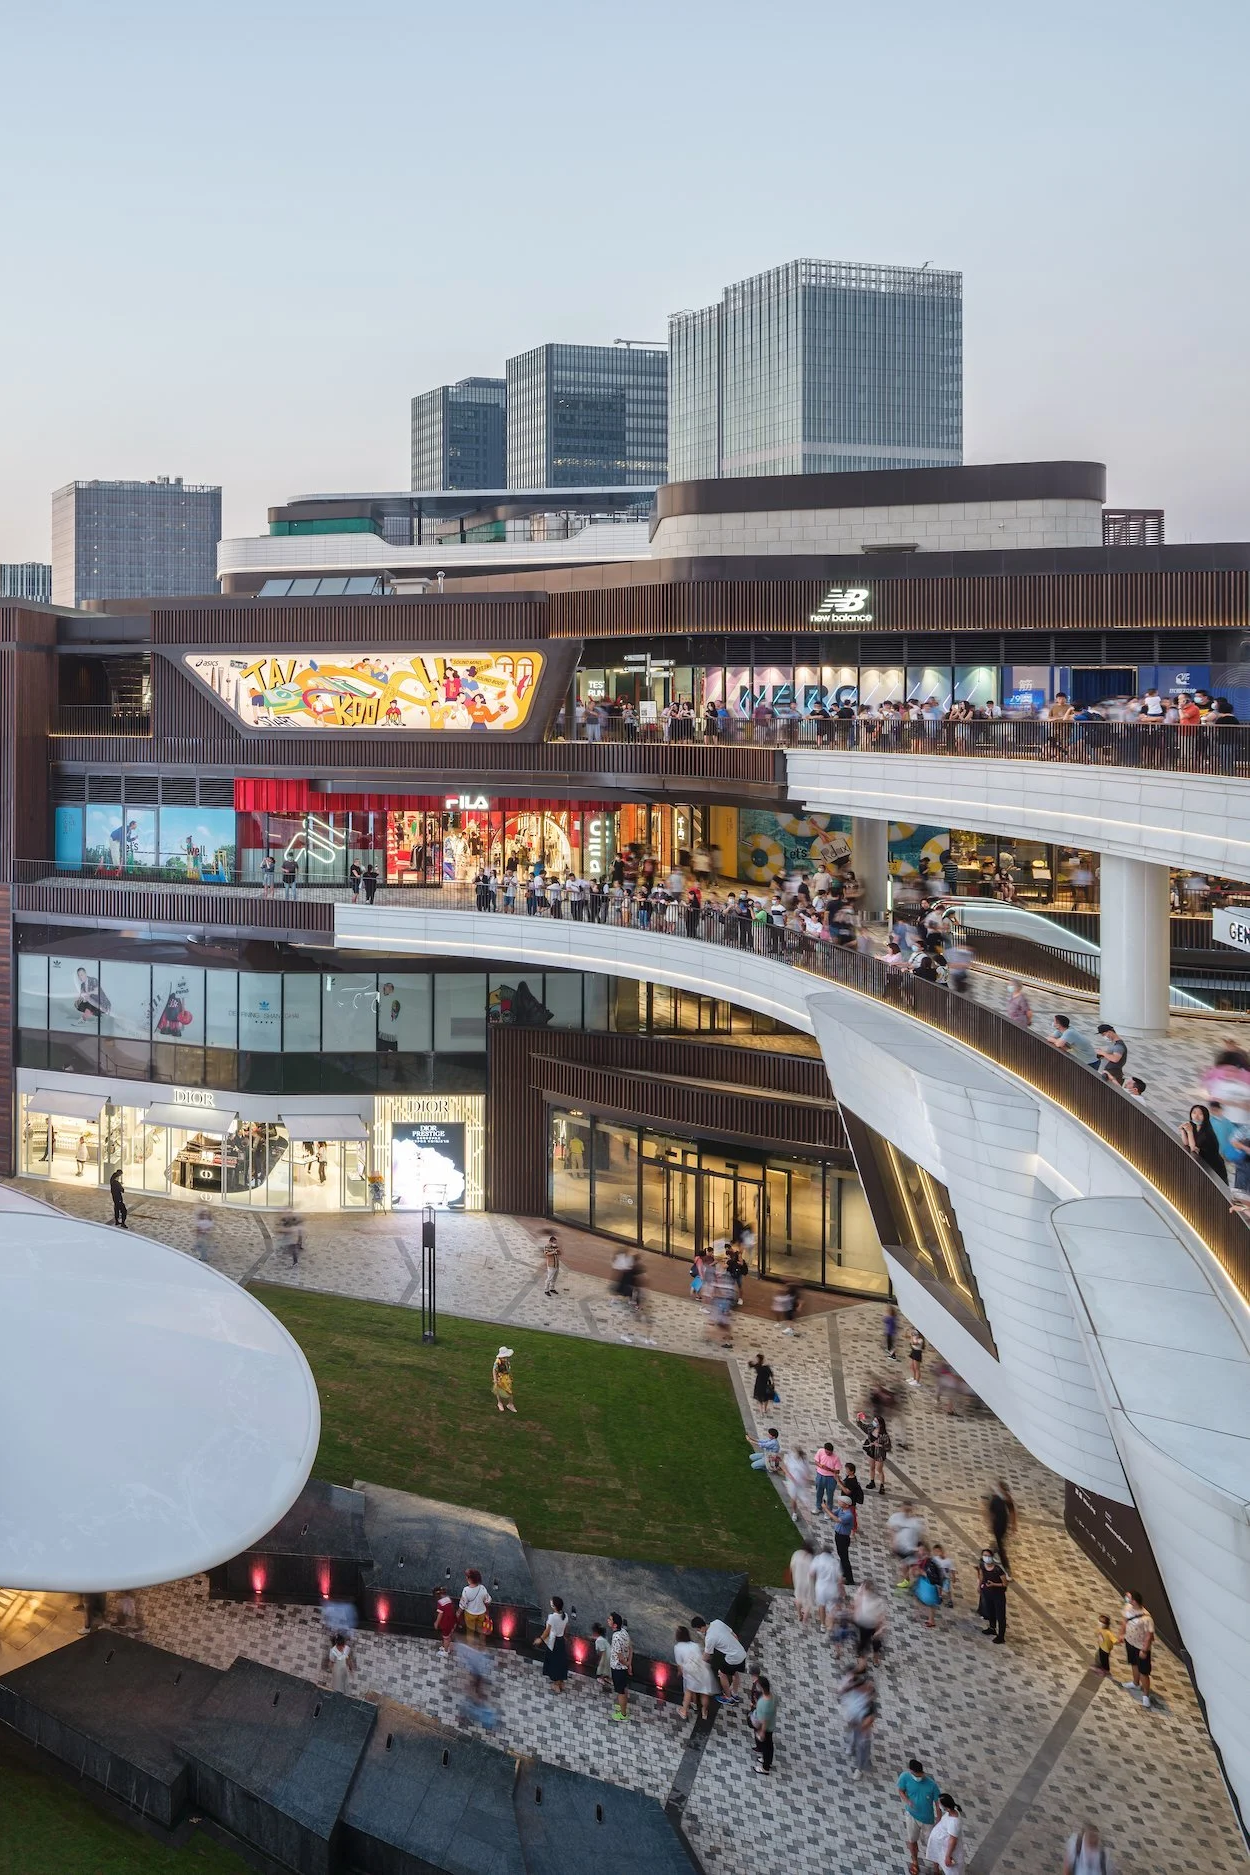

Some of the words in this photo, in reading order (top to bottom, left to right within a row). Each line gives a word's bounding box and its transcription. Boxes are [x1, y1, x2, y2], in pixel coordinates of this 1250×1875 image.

[810, 614, 830, 622] new
[831, 613, 872, 622] balance
[444, 794, 489, 810] FILA
[174, 1089, 216, 1107] DIOR
[408, 1100, 449, 1113] DIOR
